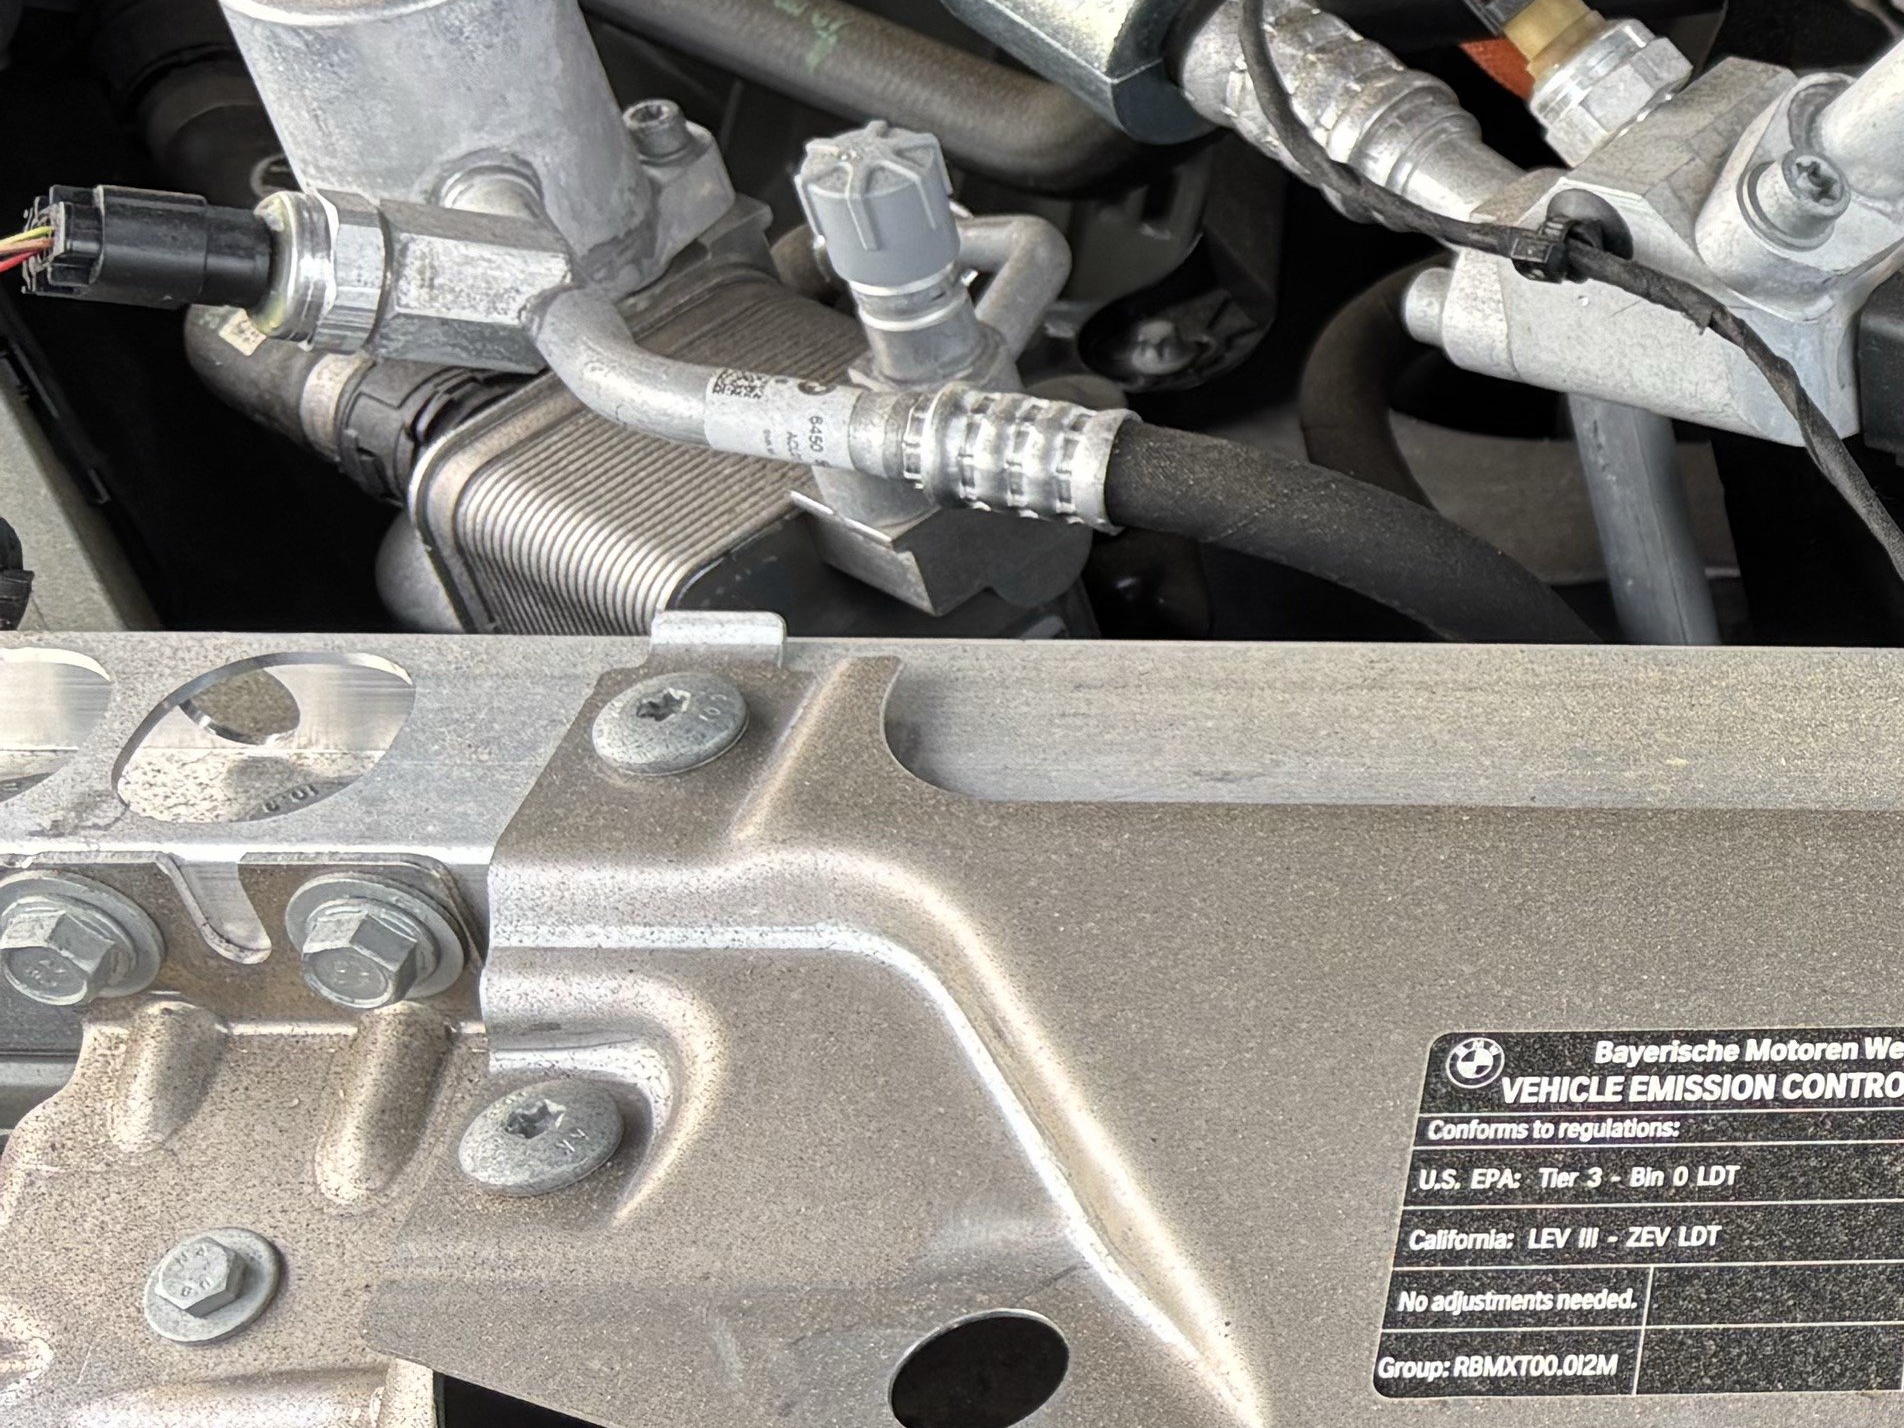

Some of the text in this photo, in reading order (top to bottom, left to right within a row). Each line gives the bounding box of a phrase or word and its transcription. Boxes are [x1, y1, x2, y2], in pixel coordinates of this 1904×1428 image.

[1595, 1038, 1740, 1068] Bayerische
[1745, 1038, 1859, 1063] Motoren
[1501, 1076, 1625, 1104] VEHICLE
[1627, 1073, 1776, 1102] EMISSION
[1427, 1118, 1681, 1142] Conforms to regulations:
[1418, 1169, 1461, 1191] U.S.
[1470, 1168, 1521, 1190] EPA:
[1540, 1167, 1579, 1189] Tier
[1587, 1167, 1603, 1188] 3
[1630, 1166, 1664, 1187] Bin
[1672, 1166, 1689, 1186] 0
[1697, 1164, 1740, 1186] LDT
[1408, 1227, 1515, 1251] California:
[1528, 1227, 1571, 1250] LEV
[1579, 1227, 1600, 1249] III
[1625, 1226, 1672, 1248] ZEV
[1677, 1225, 1723, 1247] LDT
[1397, 1288, 1638, 1315] No adjustments needed.
[1377, 1356, 1451, 1382] Group:
